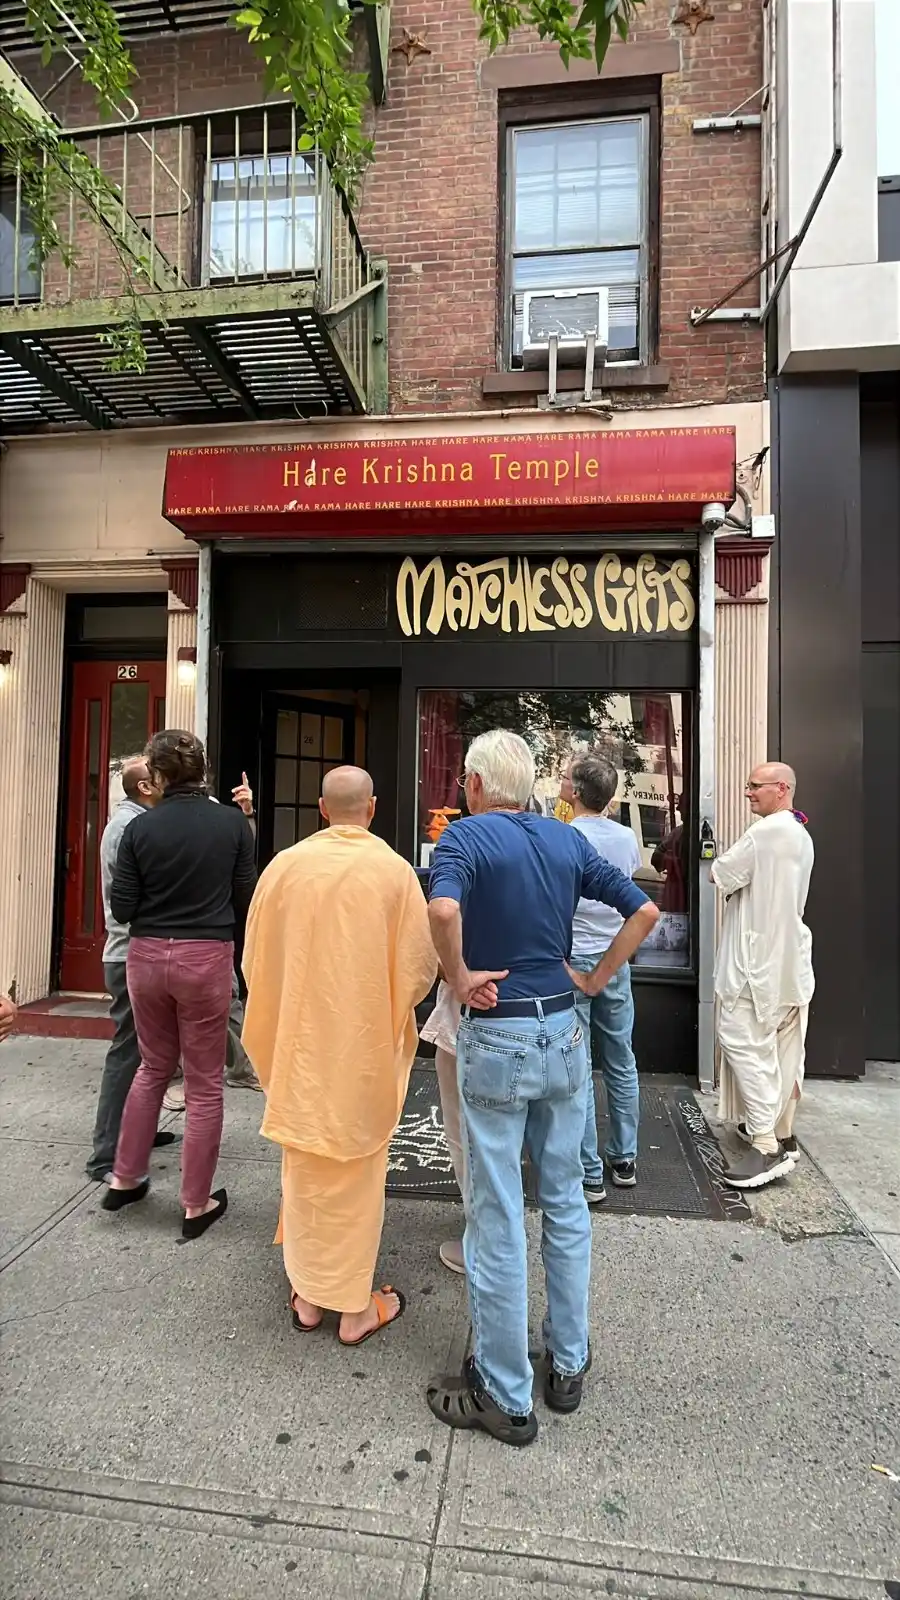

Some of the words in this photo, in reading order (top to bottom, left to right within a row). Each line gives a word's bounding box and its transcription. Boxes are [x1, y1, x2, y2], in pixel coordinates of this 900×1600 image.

[283, 461, 346, 487] Hare
[362, 456, 472, 484] Krishna
[490, 453, 599, 485] Temple
[515, 496, 560, 504] KRISHNA
[119, 666, 136, 678] 26
[304, 735, 314, 744] 26
